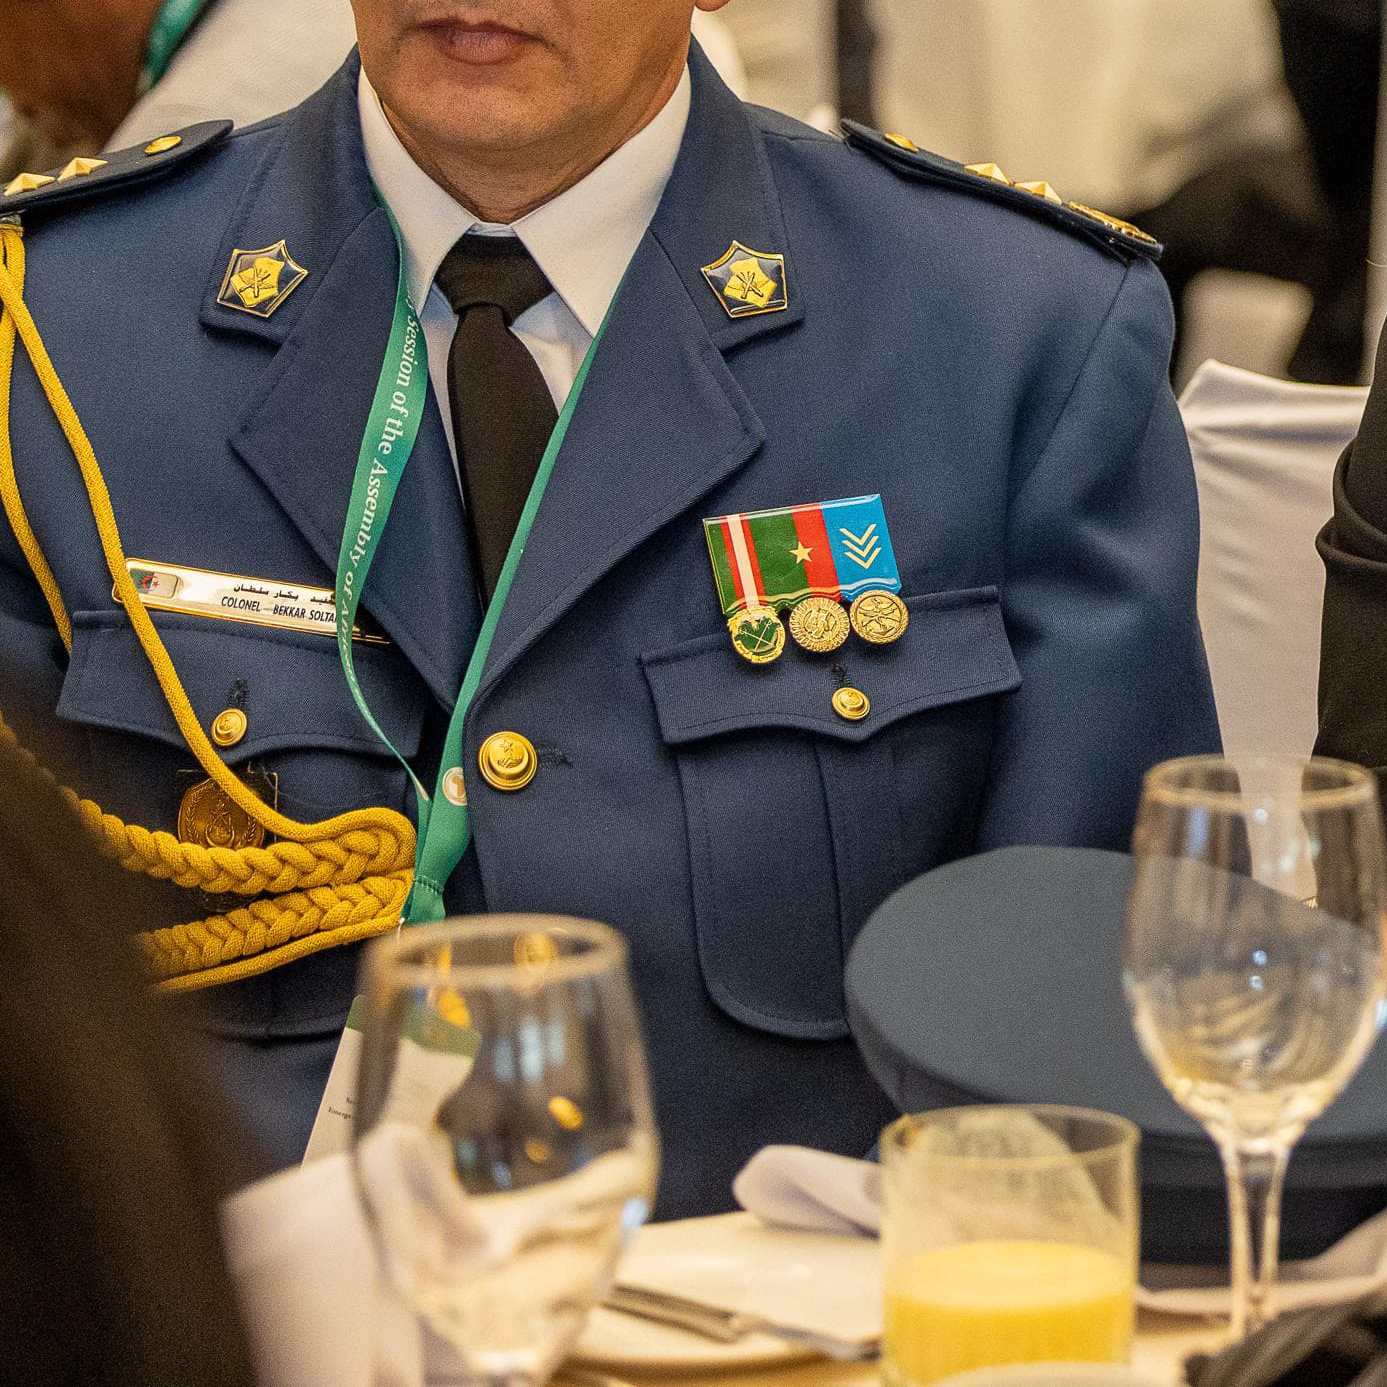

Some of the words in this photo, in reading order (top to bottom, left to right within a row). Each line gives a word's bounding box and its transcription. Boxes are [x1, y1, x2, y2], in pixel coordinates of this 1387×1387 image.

[390, 392, 410, 418] of
[378, 417, 404, 455] the
[349, 457, 388, 568] Assembly
[343, 571, 355, 601] of
[221, 596, 261, 612] COLONEL
[272, 604, 307, 620] BEKKAR
